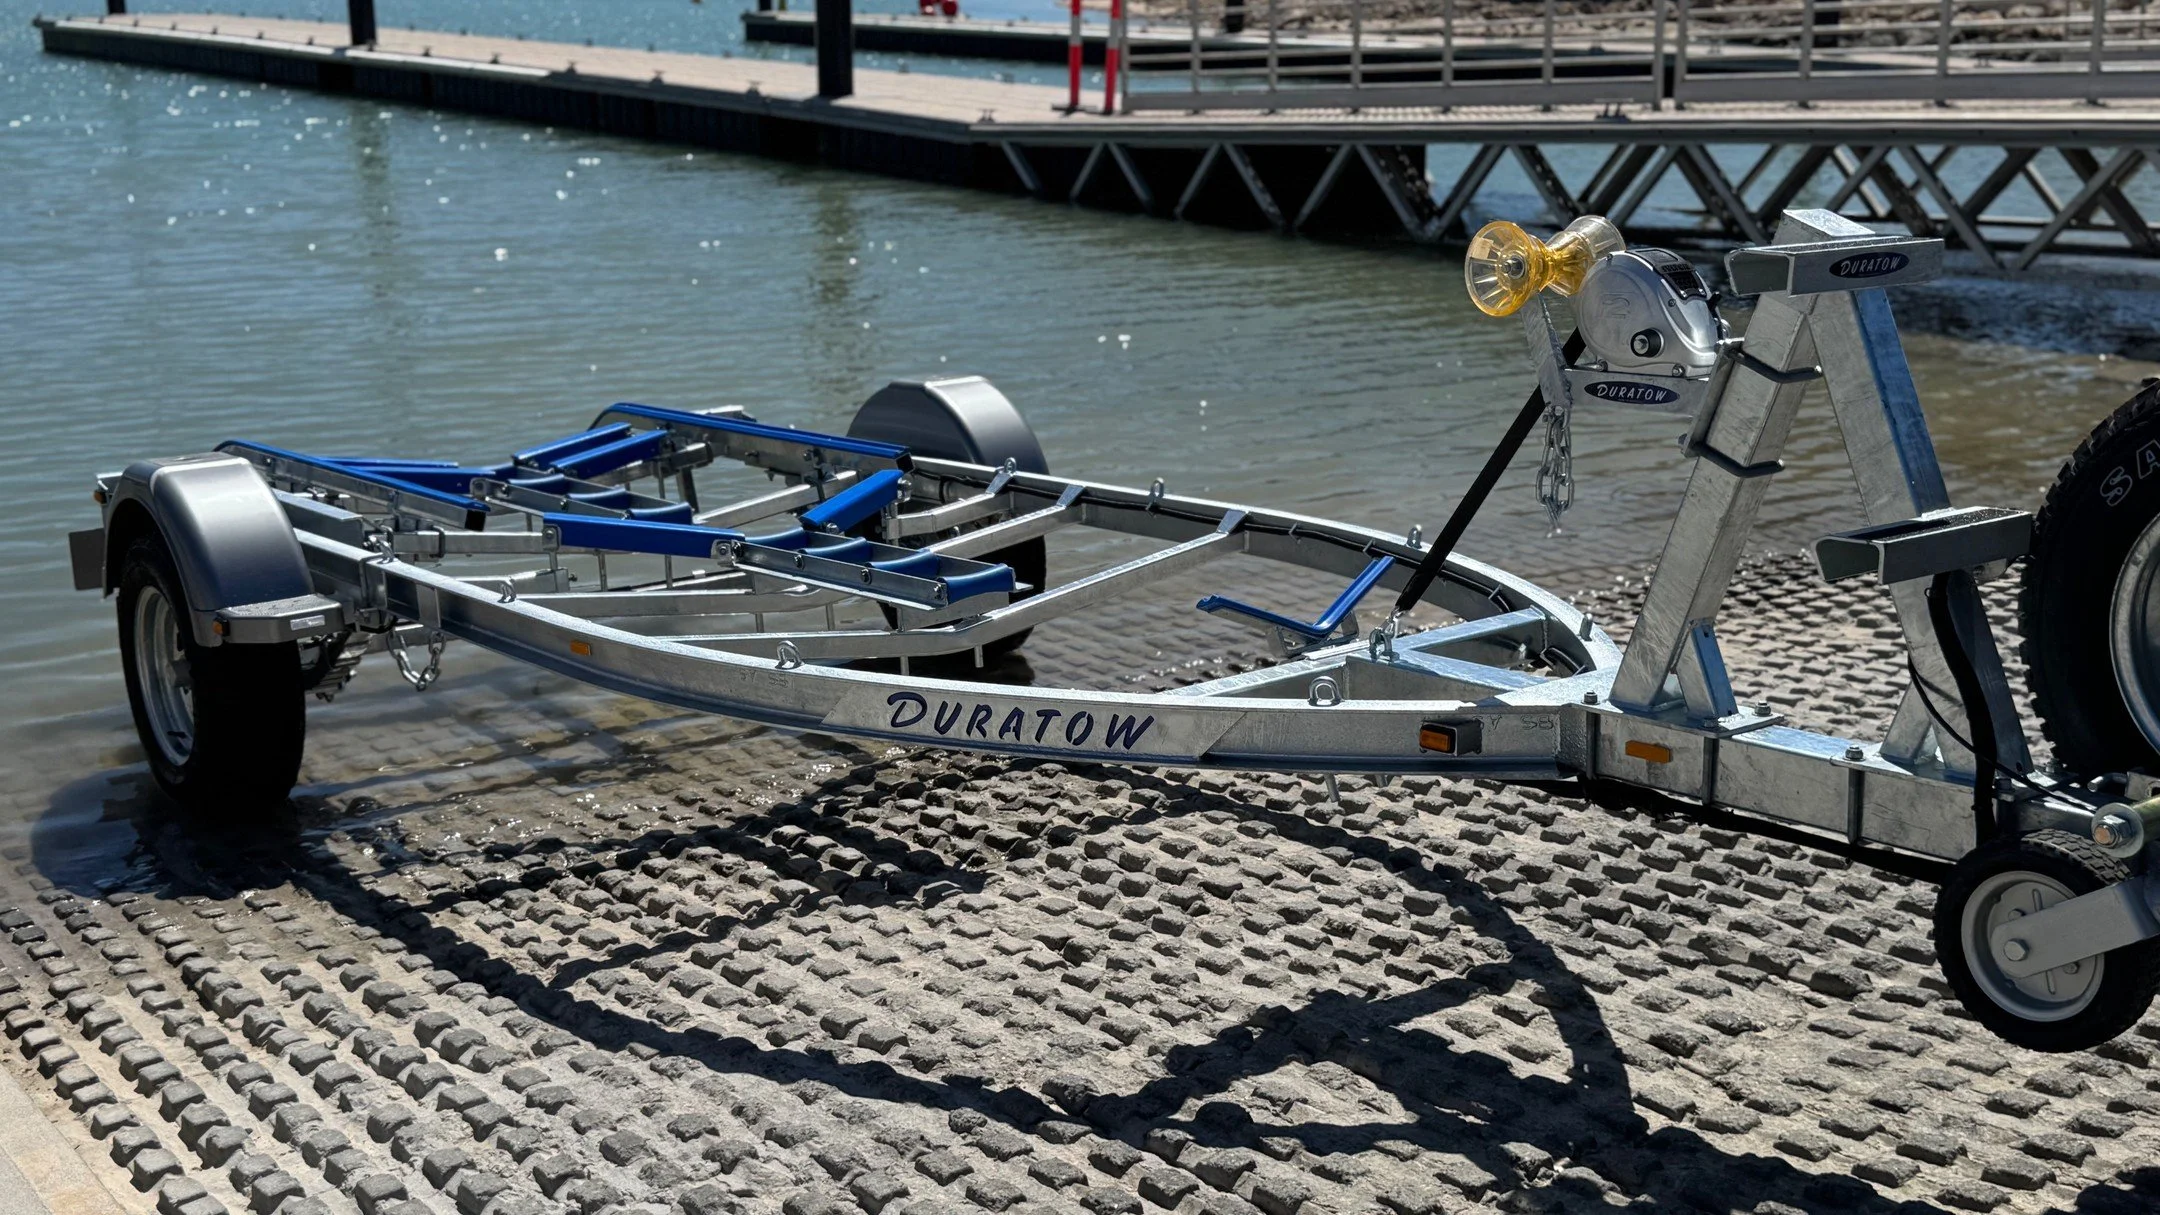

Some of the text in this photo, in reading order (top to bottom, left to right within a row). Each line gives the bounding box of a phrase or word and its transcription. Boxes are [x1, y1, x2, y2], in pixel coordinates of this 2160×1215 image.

[1840, 256, 1901, 276] DURATOW
[1596, 384, 1667, 401] DURATOW
[886, 691, 1155, 750] DURATOW
